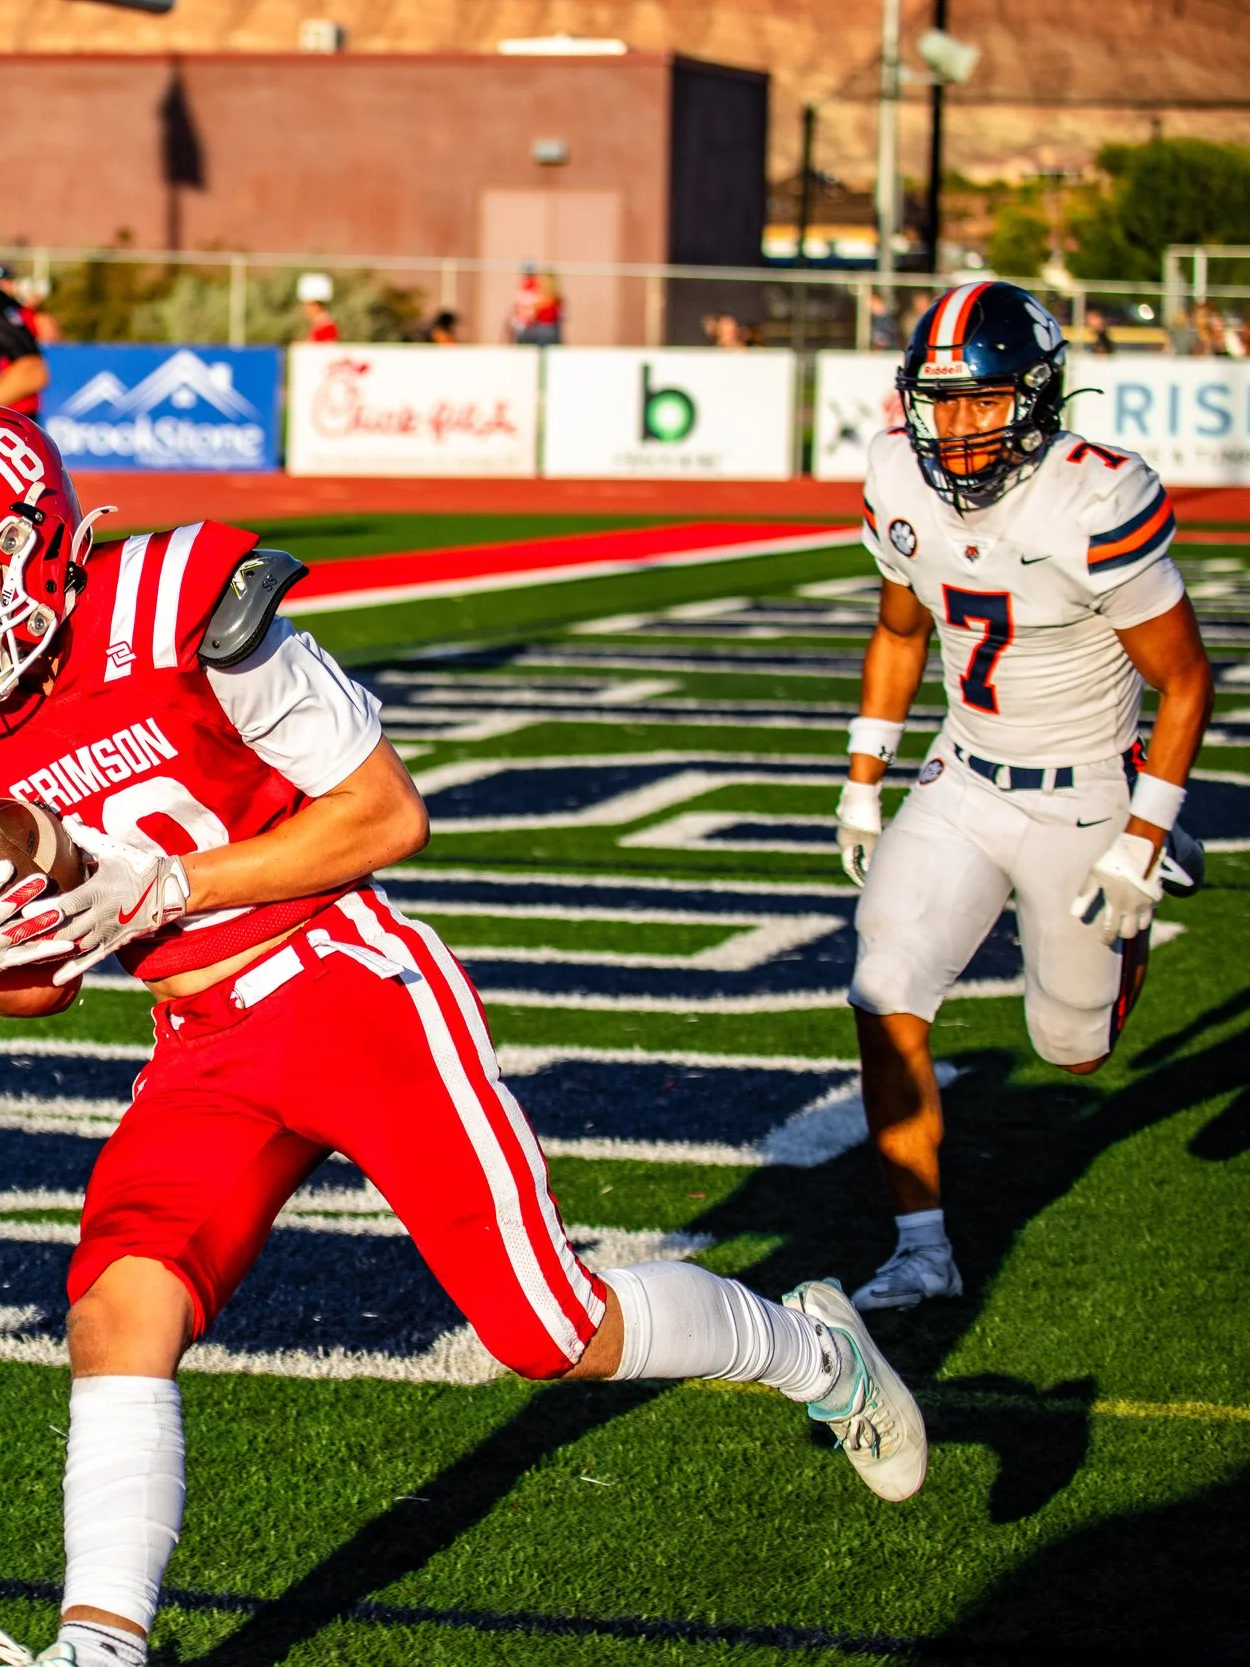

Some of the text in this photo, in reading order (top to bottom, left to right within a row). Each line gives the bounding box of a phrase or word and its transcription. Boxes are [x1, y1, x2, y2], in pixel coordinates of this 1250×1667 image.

[1115, 381, 1250, 437] RIS
[1066, 441, 1129, 470] 7
[942, 583, 1015, 715] 7
